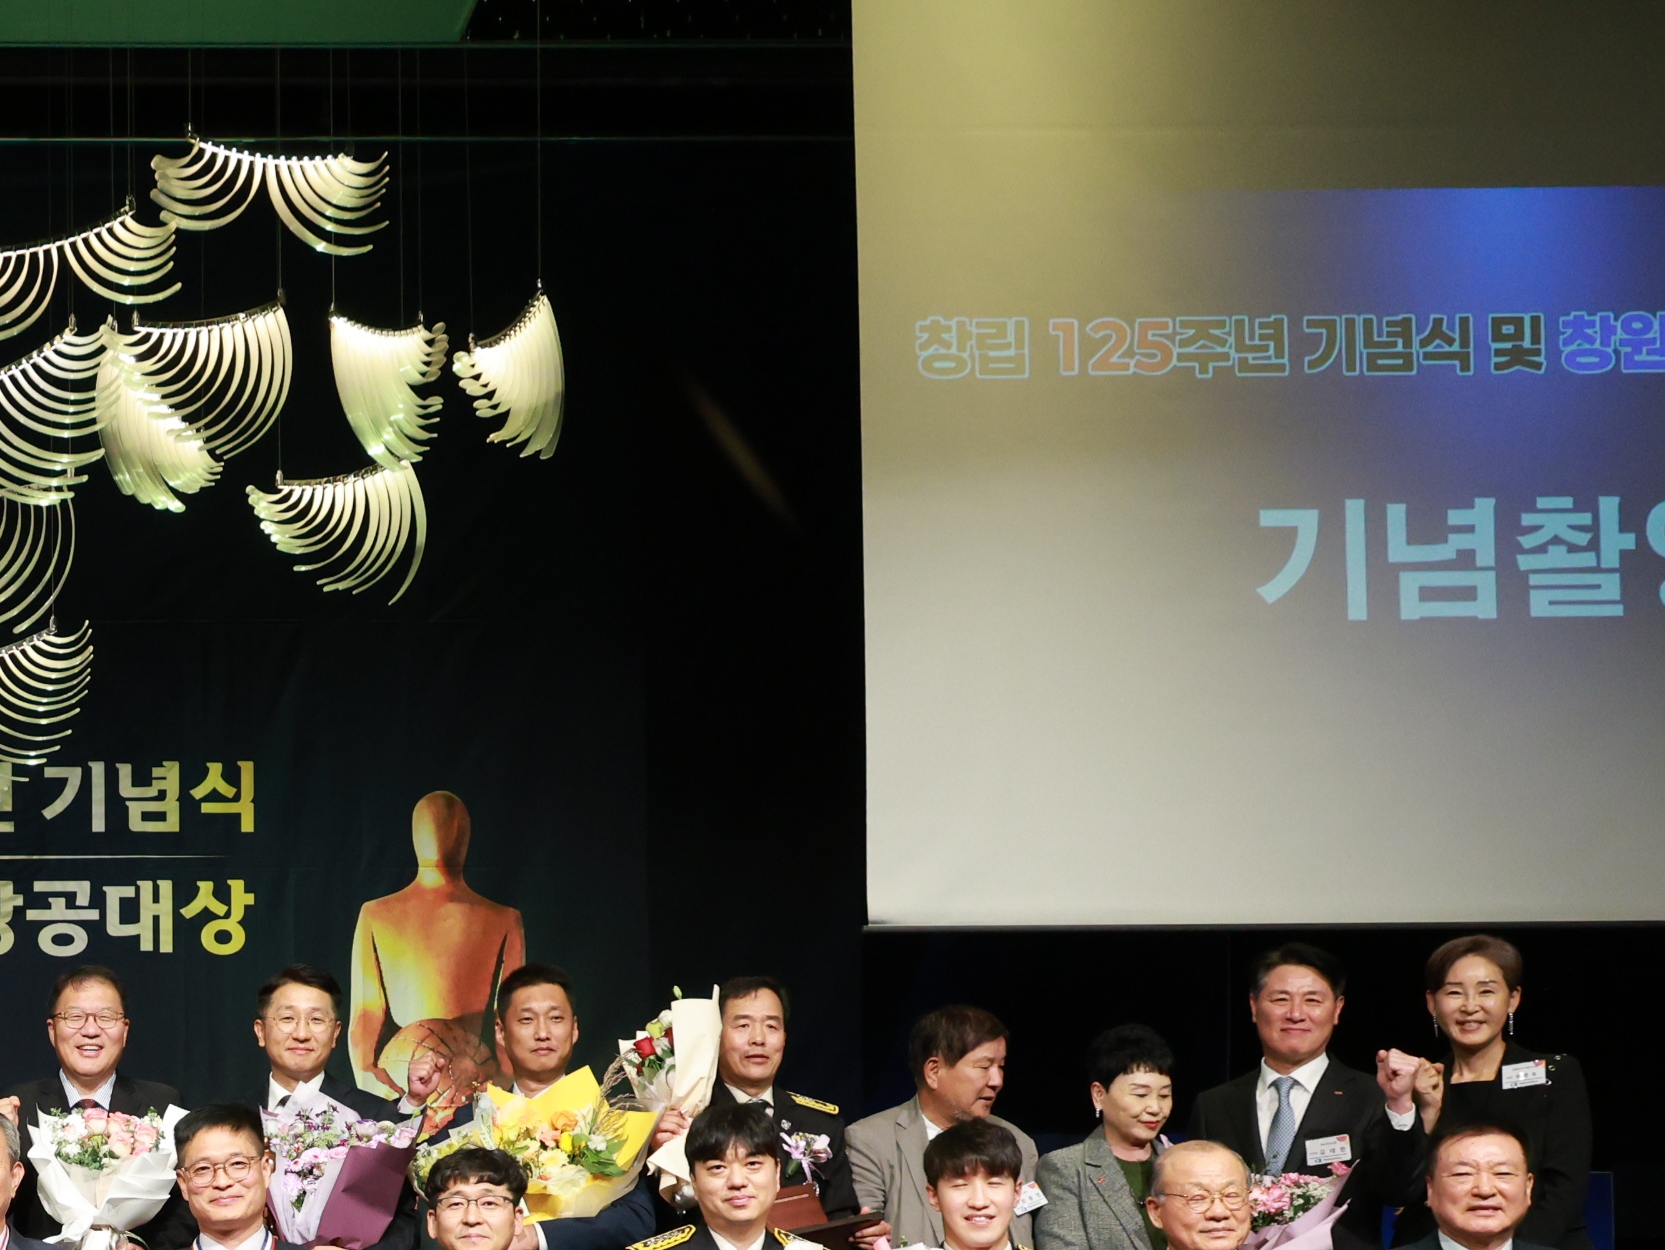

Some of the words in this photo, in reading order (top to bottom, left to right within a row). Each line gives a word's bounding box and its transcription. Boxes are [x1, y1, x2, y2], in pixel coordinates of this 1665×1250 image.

[916, 316, 1030, 380] 창립
[1049, 314, 1289, 378] 125주년
[1303, 313, 1474, 376] 기념식
[1488, 312, 1546, 374] 및
[1255, 495, 1665, 621] 기념촬
[41, 760, 255, 833] 기념식
